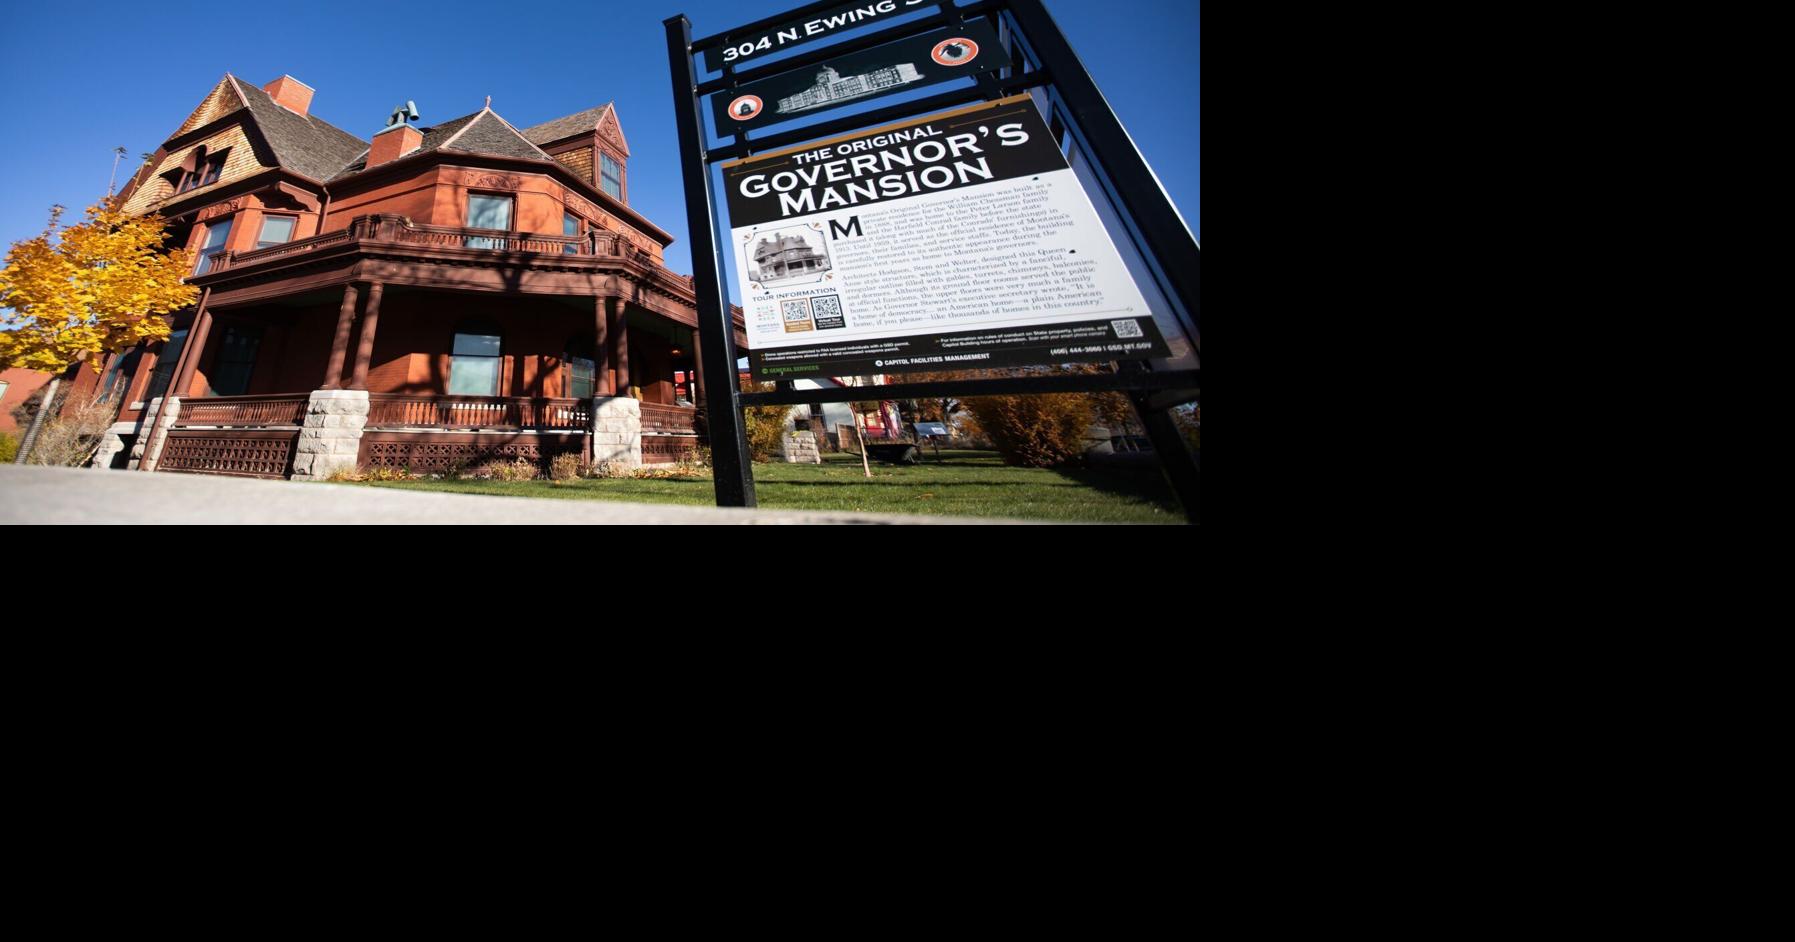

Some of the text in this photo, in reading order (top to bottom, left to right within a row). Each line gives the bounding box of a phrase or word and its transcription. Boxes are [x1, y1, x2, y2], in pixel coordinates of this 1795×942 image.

[723, 36, 772, 62] 304
[805, 0, 896, 36] EWING
[792, 125, 943, 165] THE ORIGINAL
[740, 123, 1029, 198] GOVERNOR'S
[778, 157, 994, 216] MANSION
[863, 217, 887, 225] private
[888, 211, 921, 220] residence
[947, 202, 979, 210] William
[1022, 190, 1050, 198] family
[889, 205, 921, 214] Original
[921, 198, 961, 208] Governor's
[961, 193, 995, 201] Mansion
[1022, 196, 1050, 204] family
[900, 235, 925, 243] served
[950, 227, 977, 235] official
[978, 222, 1015, 231] residence
[1026, 214, 1071, 224] Montana's
[924, 217, 953, 226] Conrad
[1037, 221, 1075, 229] building
[845, 256, 875, 264] carefully
[877, 251, 907, 259] restored
[928, 244, 964, 252] authentic
[964, 237, 1011, 247] appearance
[953, 246, 995, 256] Montana's
[842, 272, 877, 280] Architects
[980, 253, 1018, 262] designed
[1036, 248, 1067, 256] Queen
[952, 262, 1008, 273] characterized
[1007, 265, 1051, 274] chimneys,
[1052, 260, 1098, 268] balconies,
[882, 295, 920, 303] functions,
[1027, 279, 1052, 287] much
[1061, 275, 1092, 283] family
[894, 286, 929, 294] Although
[942, 281, 971, 290] ground
[1020, 272, 1050, 280] served
[1068, 267, 1096, 275] public
[777, 287, 836, 299] INFORMATION
[883, 302, 919, 310] Governor
[919, 297, 957, 306] Stewart's
[958, 294, 997, 302] executive
[998, 289, 1039, 297] secretary
[948, 302, 989, 310] American
[1056, 291, 1103, 299] American
[947, 310, 991, 318] thousands
[945, 353, 990, 361] MANAGEMENT
